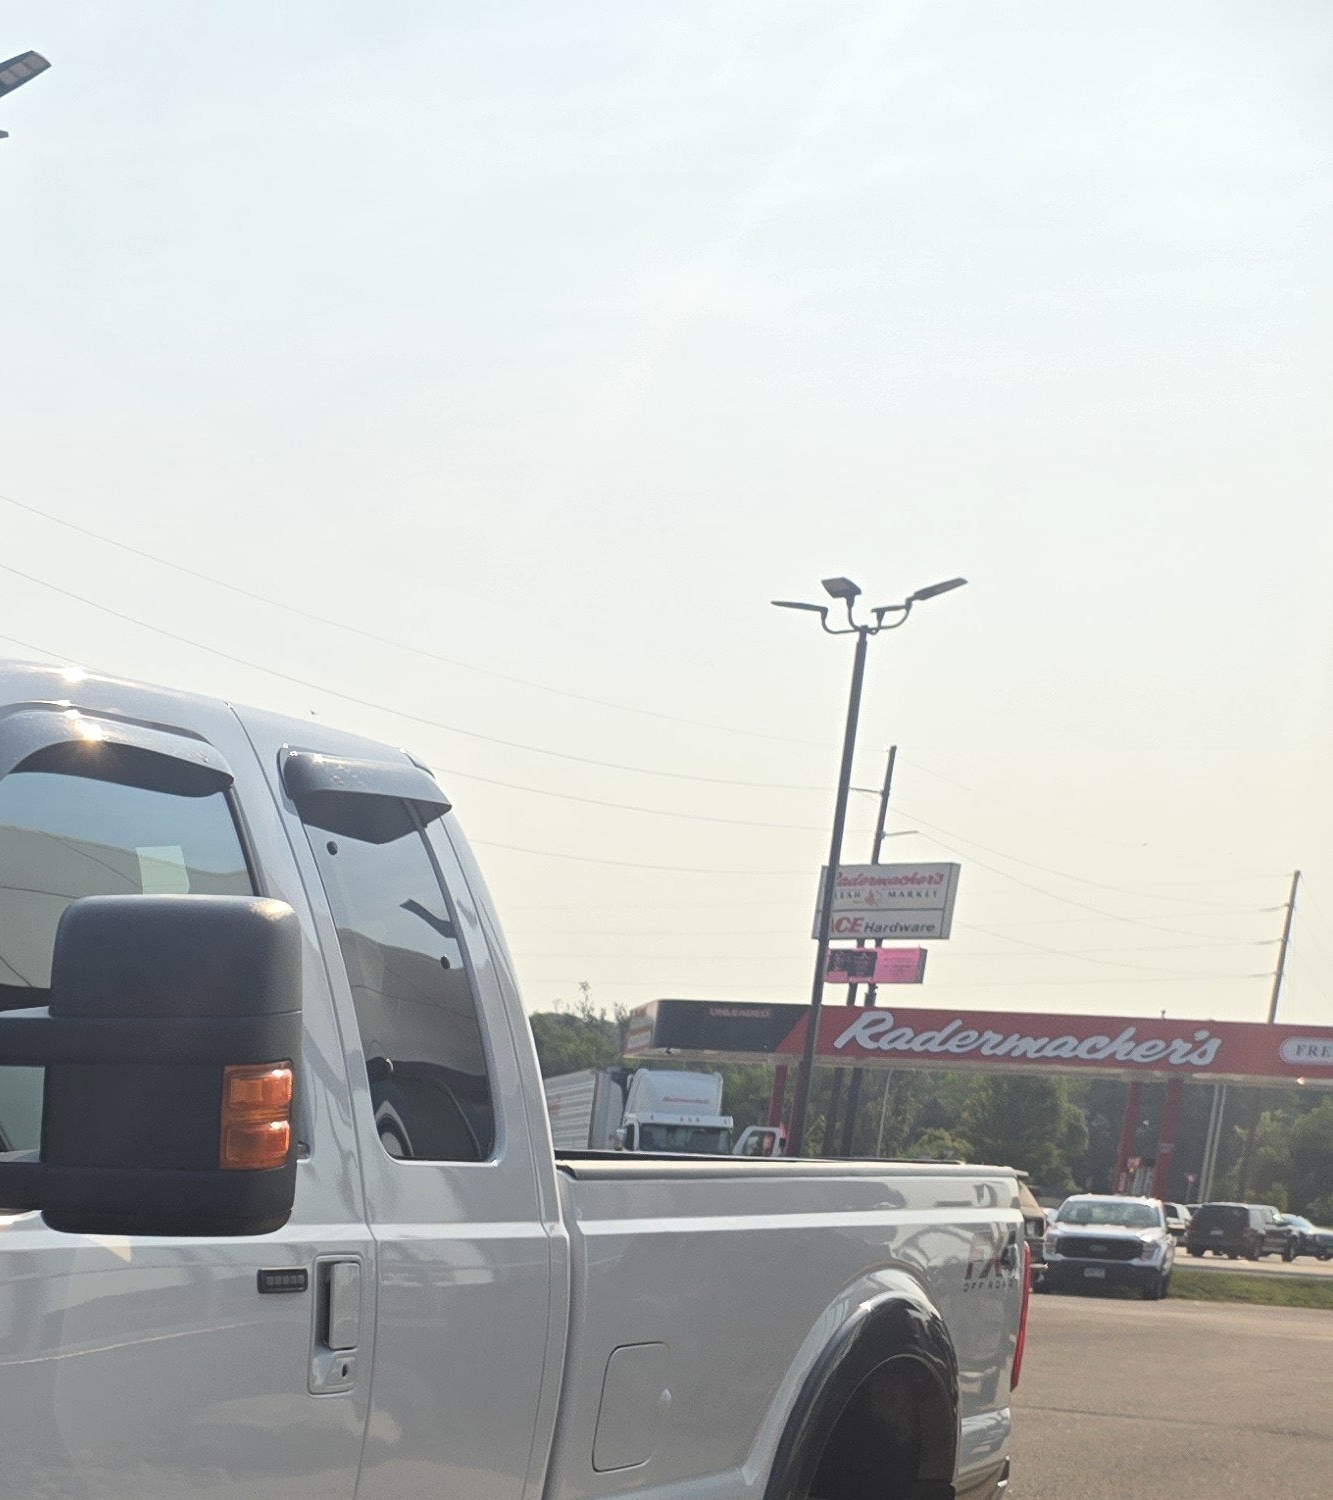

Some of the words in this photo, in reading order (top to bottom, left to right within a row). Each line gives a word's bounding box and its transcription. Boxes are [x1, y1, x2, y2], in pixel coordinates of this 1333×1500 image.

[832, 916, 865, 934] CE
[864, 921, 935, 932] Hardware
[834, 1011, 1221, 1066] Radermacher's
